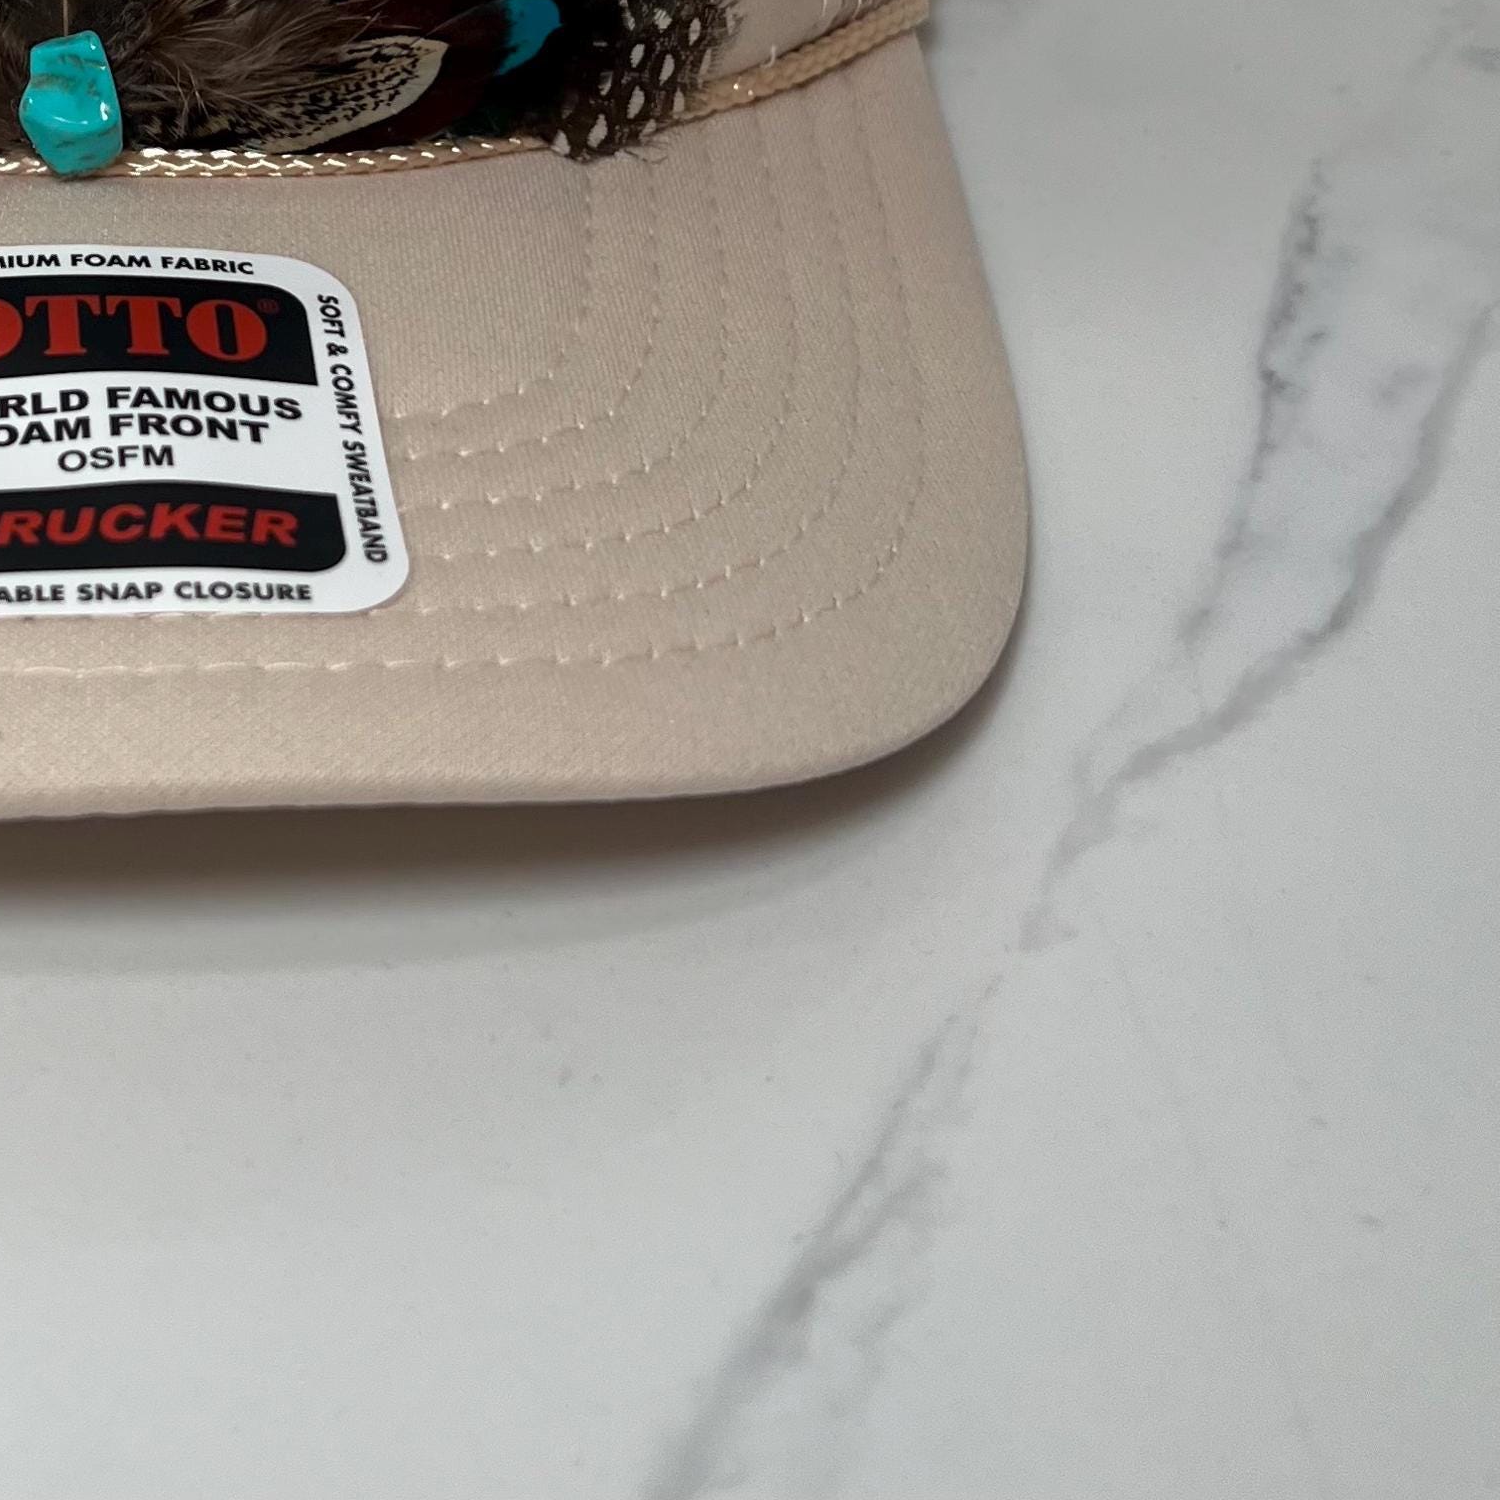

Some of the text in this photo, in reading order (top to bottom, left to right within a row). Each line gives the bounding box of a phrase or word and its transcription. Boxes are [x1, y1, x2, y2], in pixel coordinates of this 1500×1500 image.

[70, 253, 152, 269] FOAM
[161, 256, 255, 275] FABRIC
[106, 386, 302, 420] FAMOUS
[109, 414, 270, 443] FRONT
[317, 294, 388, 563] SOFT & COMFY SWEATBAND
[57, 445, 175, 472] OSFM
[77, 582, 163, 602] SNAP
[174, 581, 312, 601] CLOSURE
